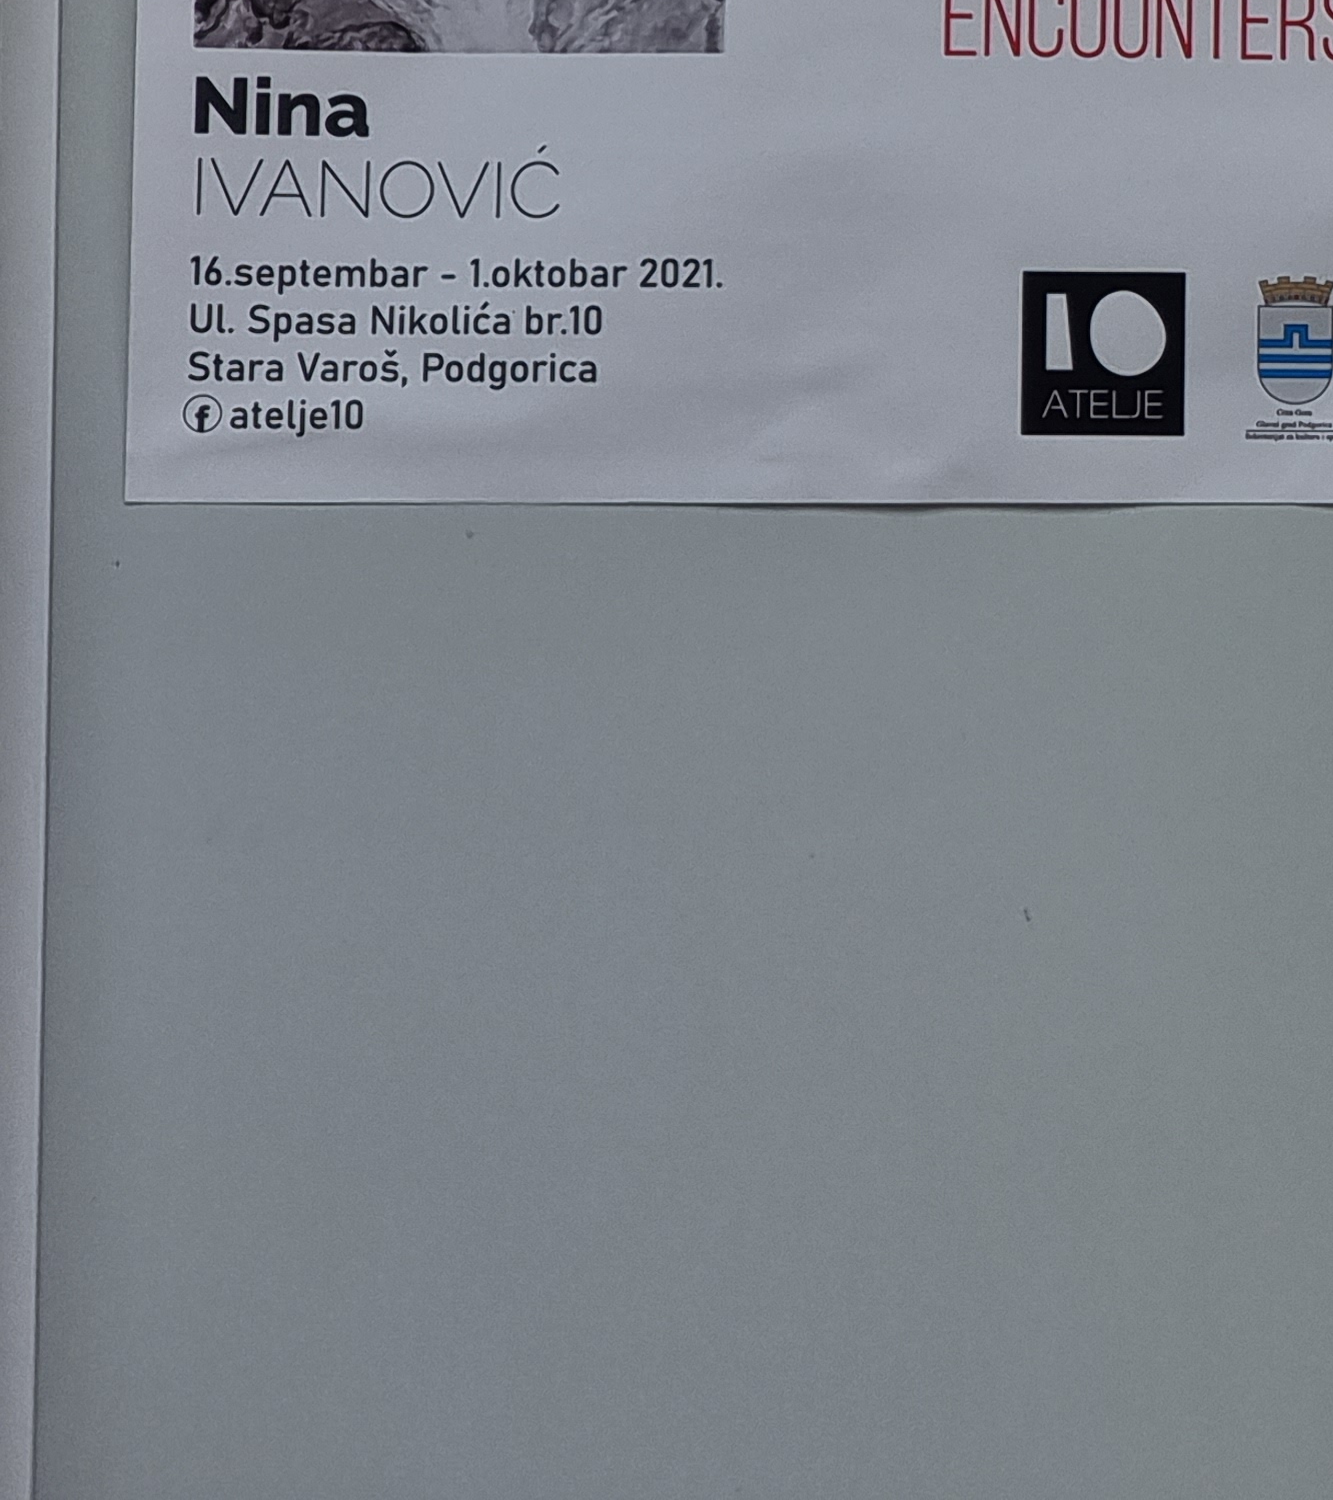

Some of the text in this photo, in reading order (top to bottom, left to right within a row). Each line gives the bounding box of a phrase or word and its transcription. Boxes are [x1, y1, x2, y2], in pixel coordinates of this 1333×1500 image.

[194, 76, 370, 138] Nina
[195, 144, 560, 219] IVANOVIĆ
[190, 255, 429, 295] 16.septembar
[470, 257, 628, 288] 1.oktobar
[639, 257, 723, 289] 2021.
[190, 301, 603, 343] Ul. Spasa Nikolića br.10
[187, 349, 597, 391] Stara Varoš, Podgorica
[229, 398, 364, 438] atelje10
[1041, 389, 1163, 419] ATELJE
